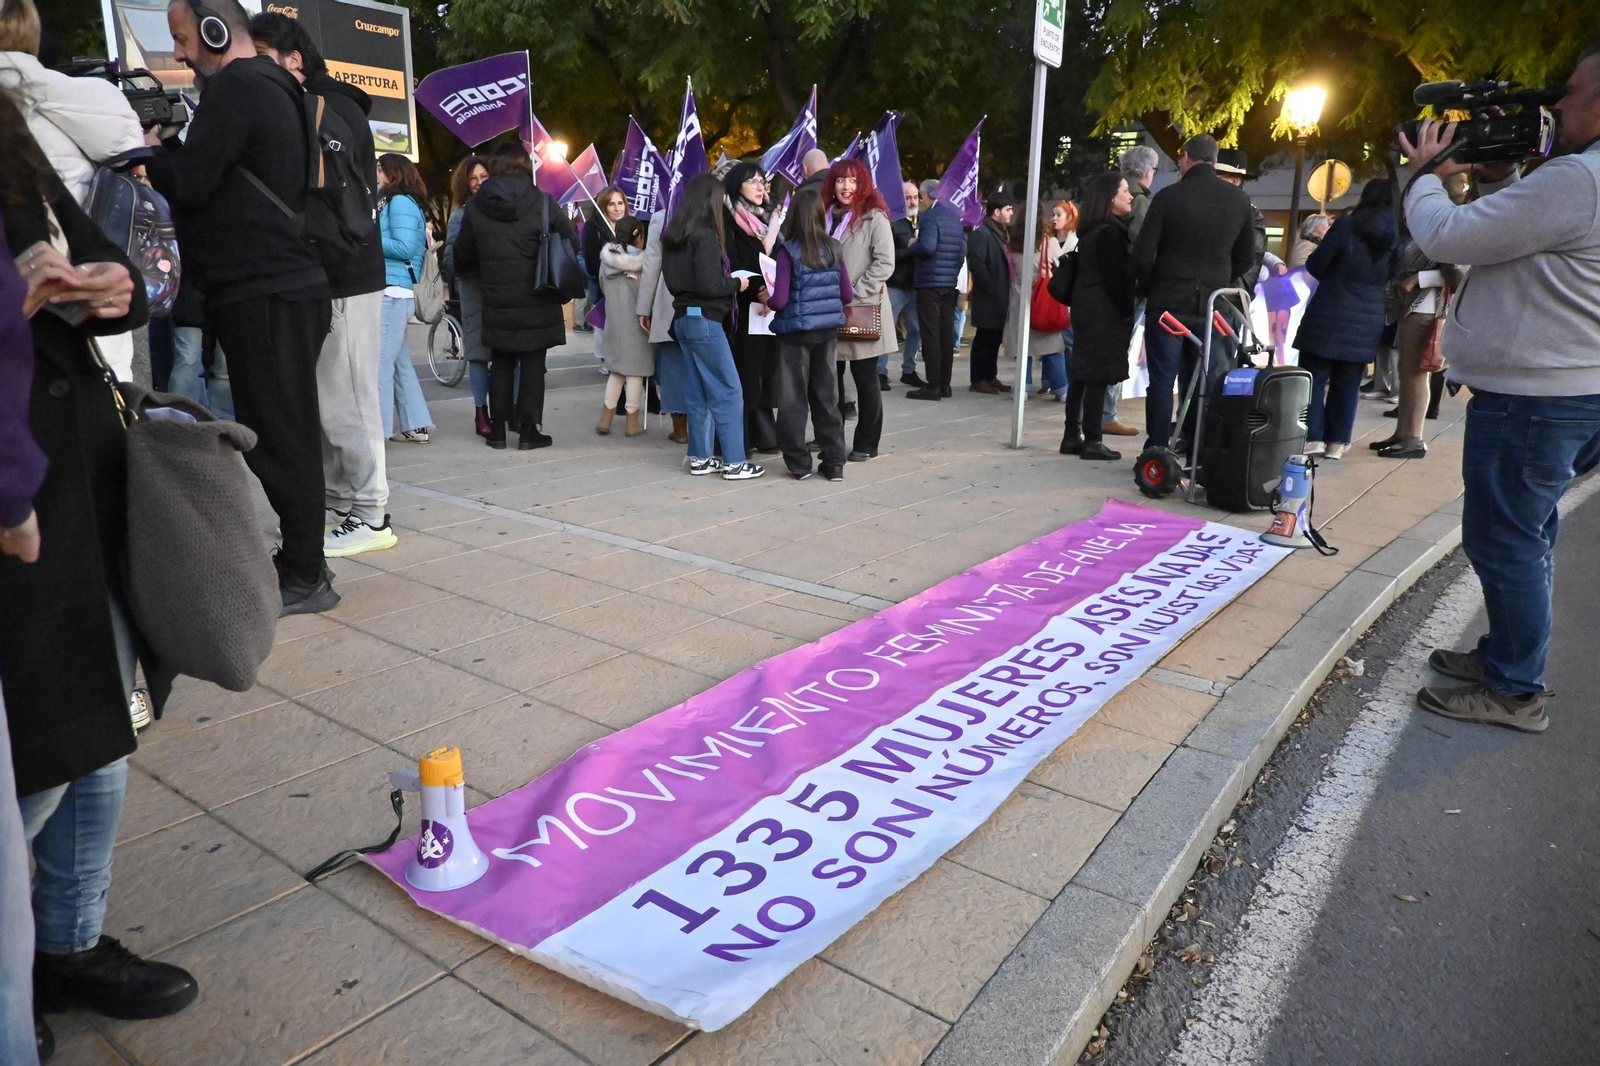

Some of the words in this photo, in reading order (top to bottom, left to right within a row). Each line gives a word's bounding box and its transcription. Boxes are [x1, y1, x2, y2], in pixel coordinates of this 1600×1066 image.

[354, 19, 400, 37] Cruzcampo
[1043, 27, 1055, 40] PUNTO
[1040, 37, 1061, 55] ENCUENTRO
[334, 71, 399, 90] APERTURA
[491, 668, 880, 868] MOVIMIENTO
[1023, 560, 1081, 585] DE
[1067, 522, 1157, 566] HUELVA
[632, 782, 860, 935] 1335
[840, 637, 1086, 784] MUJERES
[1070, 531, 1233, 636] ASESINADAS
[702, 895, 816, 963] NO
[812, 797, 935, 890] SON
[916, 680, 1108, 802] NÚMEROS,
[1084, 632, 1151, 676] SON
[1131, 573, 1232, 635] NUESTAS
